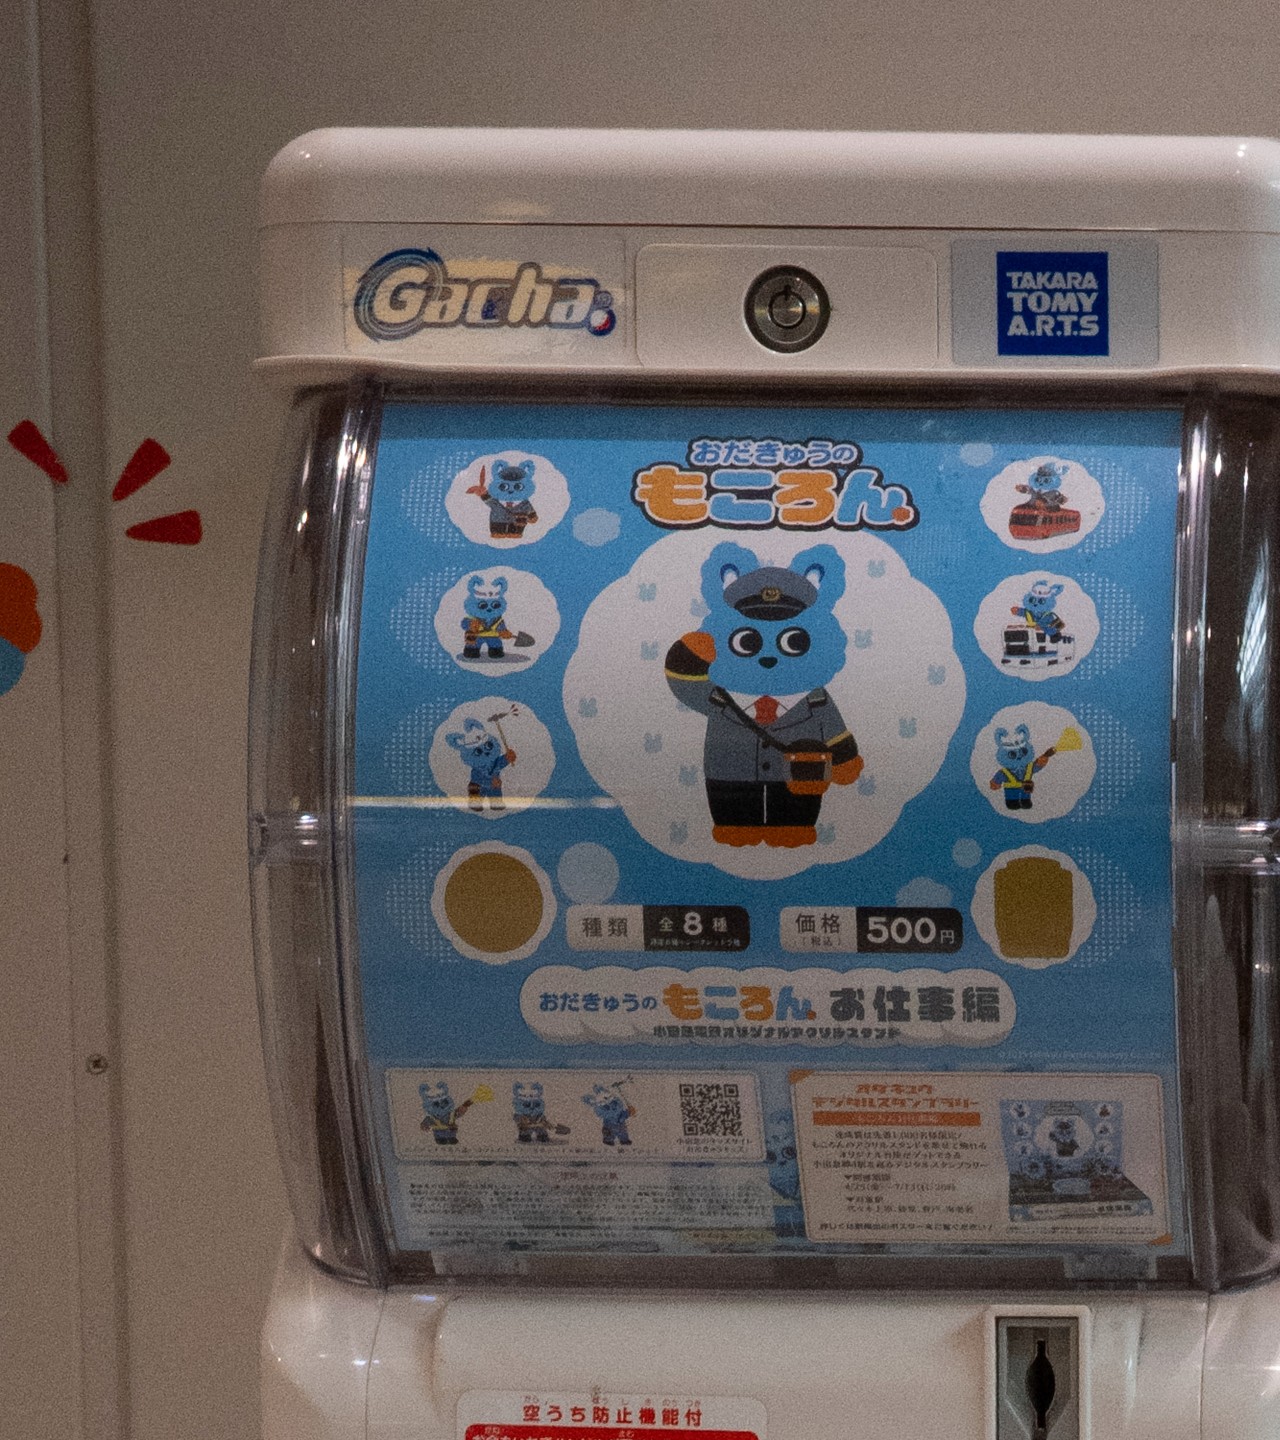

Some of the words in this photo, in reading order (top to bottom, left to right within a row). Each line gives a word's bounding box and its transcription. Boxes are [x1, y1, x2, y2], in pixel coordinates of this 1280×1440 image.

[1006, 271, 1099, 290] TAKARA
[1008, 291, 1100, 314] TOMY
[690, 440, 858, 466] おだきゅうの
[582, 917, 629, 938] 種類
[795, 913, 841, 934] 価格
[868, 917, 955, 945] 500円
[540, 993, 658, 1013] おだきゅうの
[829, 985, 1000, 1023] お仕事編
